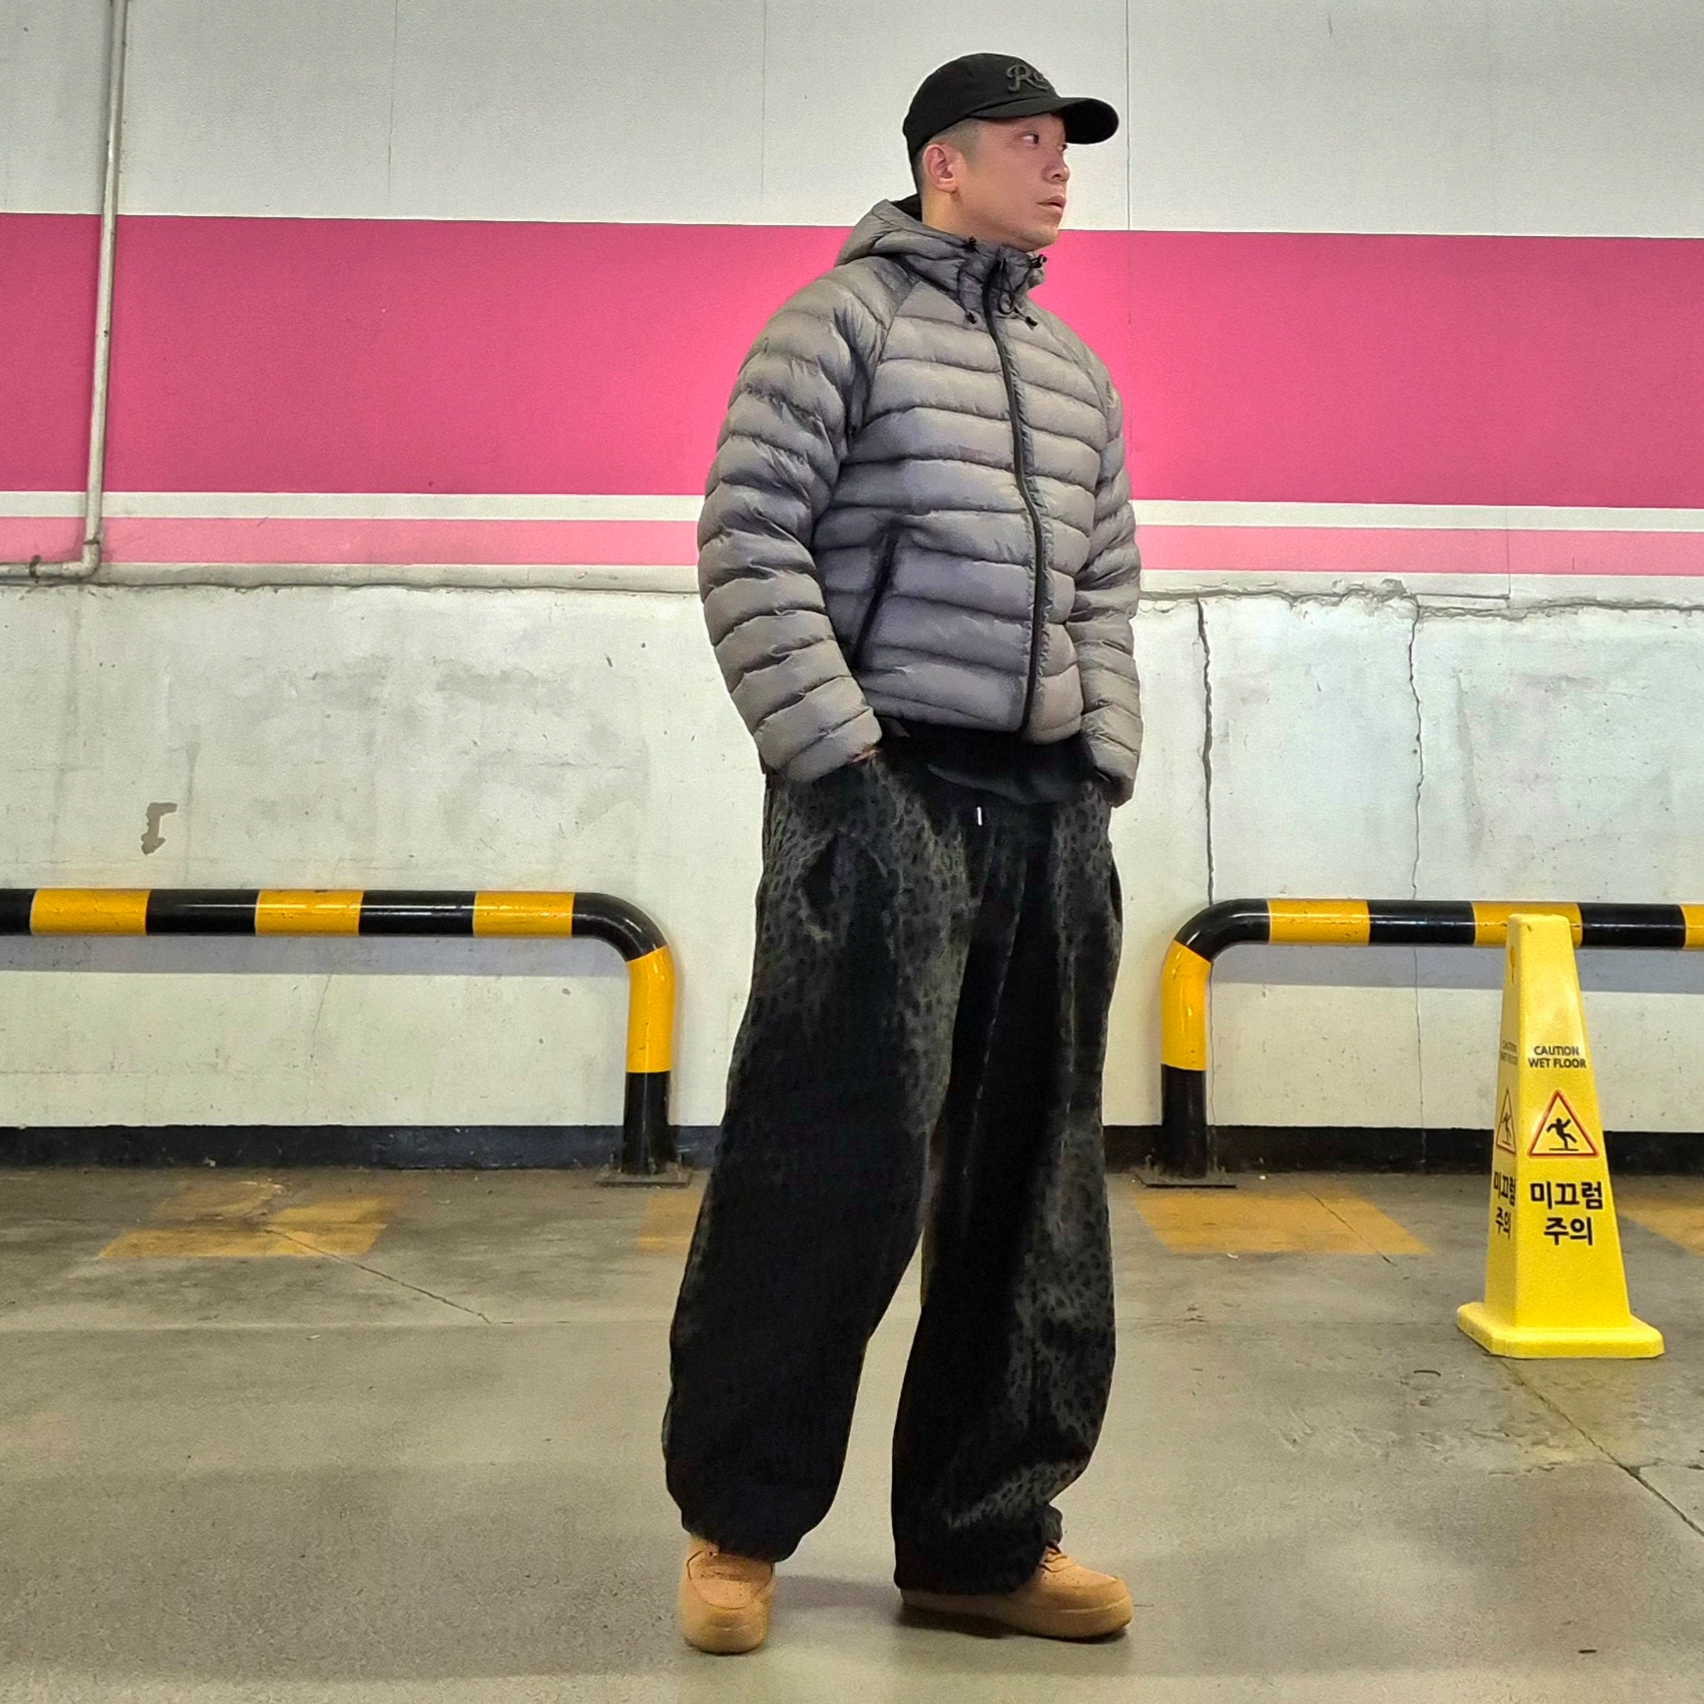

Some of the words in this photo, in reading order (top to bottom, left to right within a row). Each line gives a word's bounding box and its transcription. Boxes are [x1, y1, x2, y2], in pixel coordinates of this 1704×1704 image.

[1528, 1058, 1551, 1069] WET
[1553, 1058, 1587, 1069] FLOOR
[1533, 1045, 1580, 1056] CAUTION
[1530, 1181, 1604, 1210] 미끄럼
[1495, 1206, 1511, 1240] 주의
[1543, 1216, 1593, 1246] 주의
